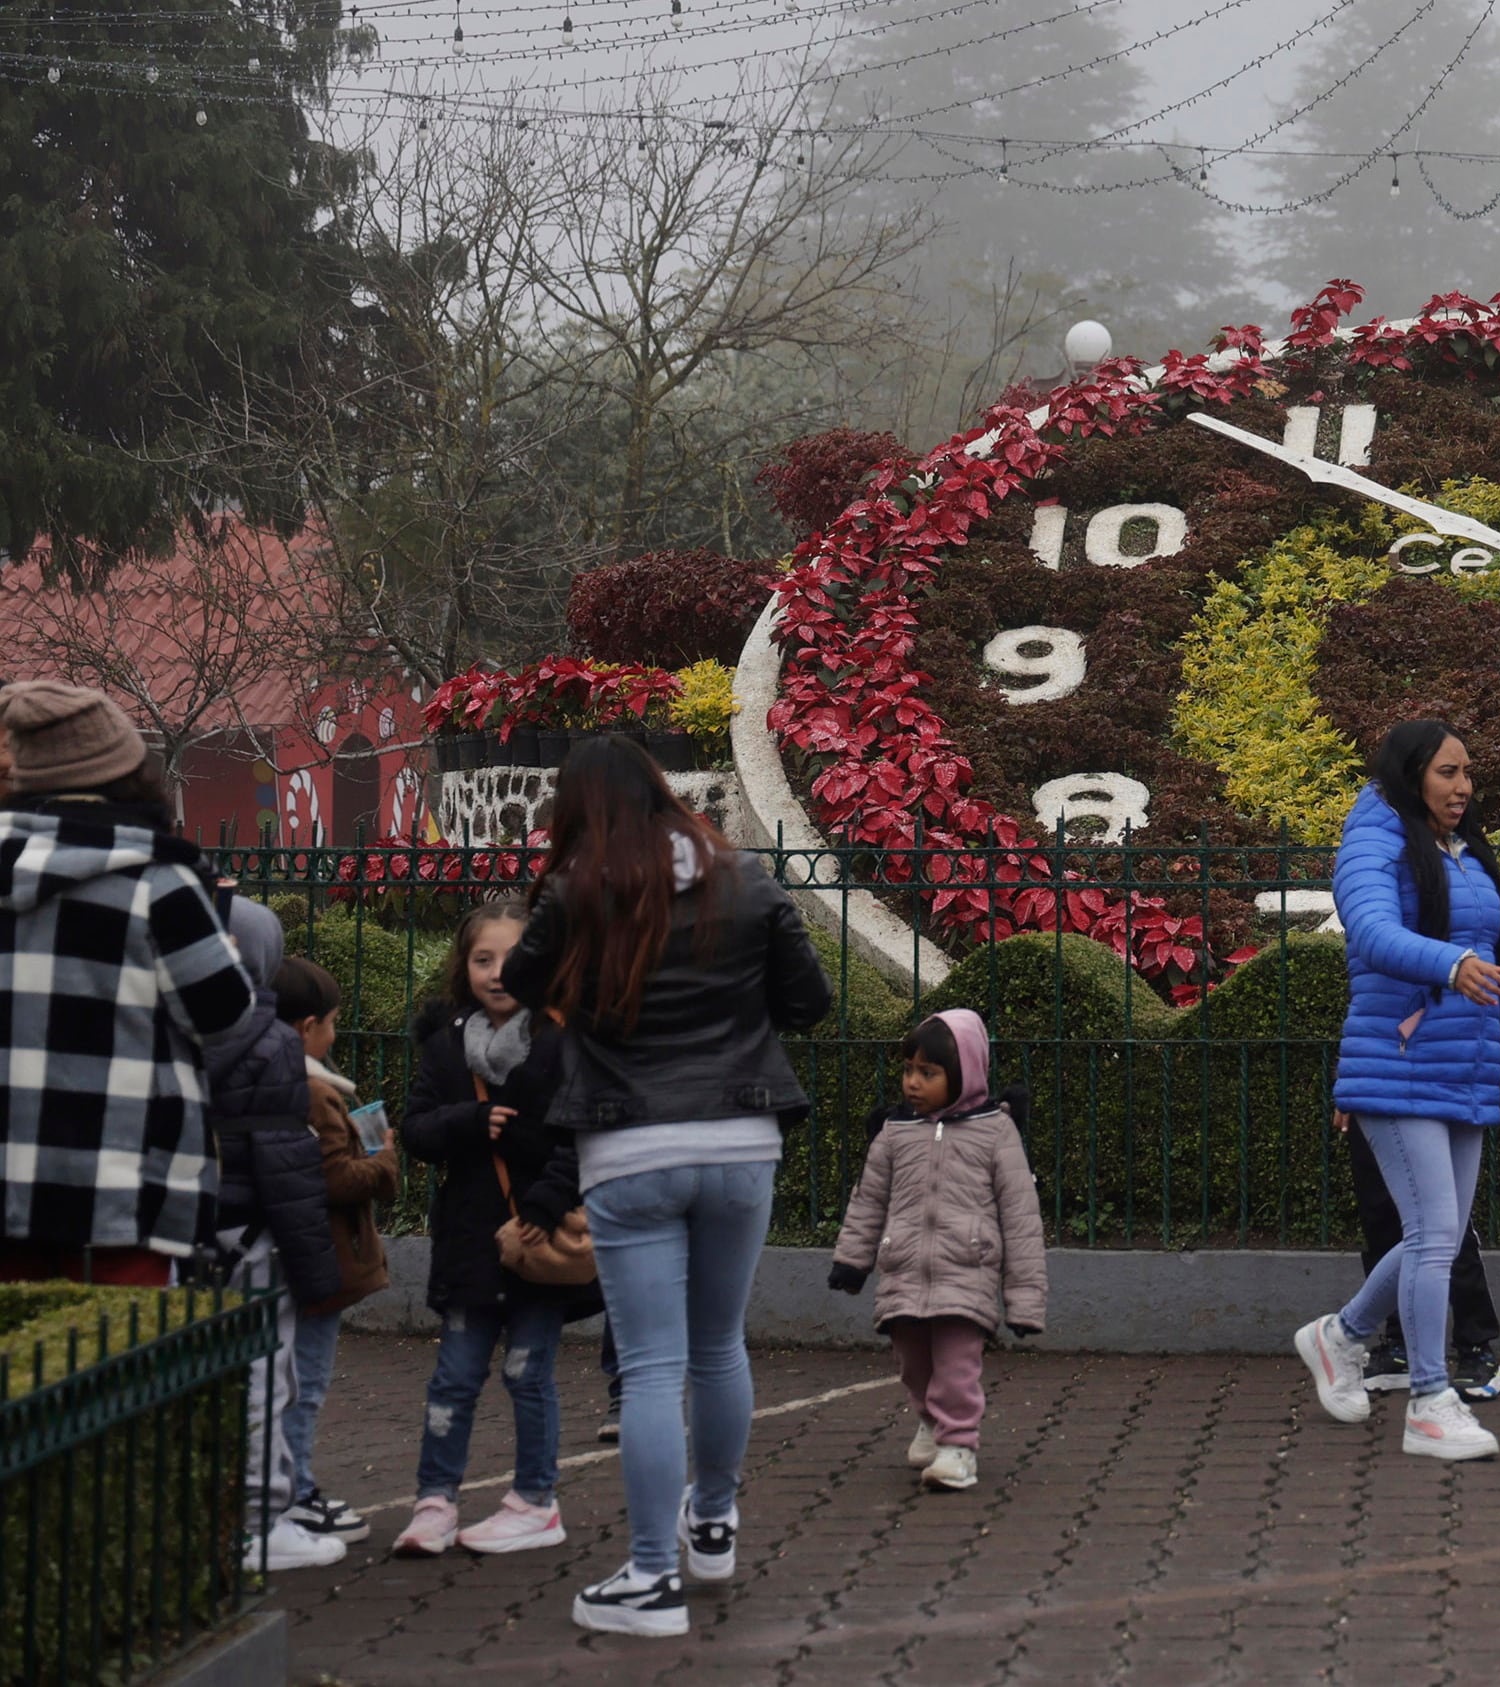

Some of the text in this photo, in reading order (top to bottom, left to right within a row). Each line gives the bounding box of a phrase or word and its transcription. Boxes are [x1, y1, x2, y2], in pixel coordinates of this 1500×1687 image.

[1283, 403, 1377, 467] 11
[1028, 502, 1190, 571] 10
[983, 625, 1088, 705] 9
[1031, 771, 1150, 845] 8
